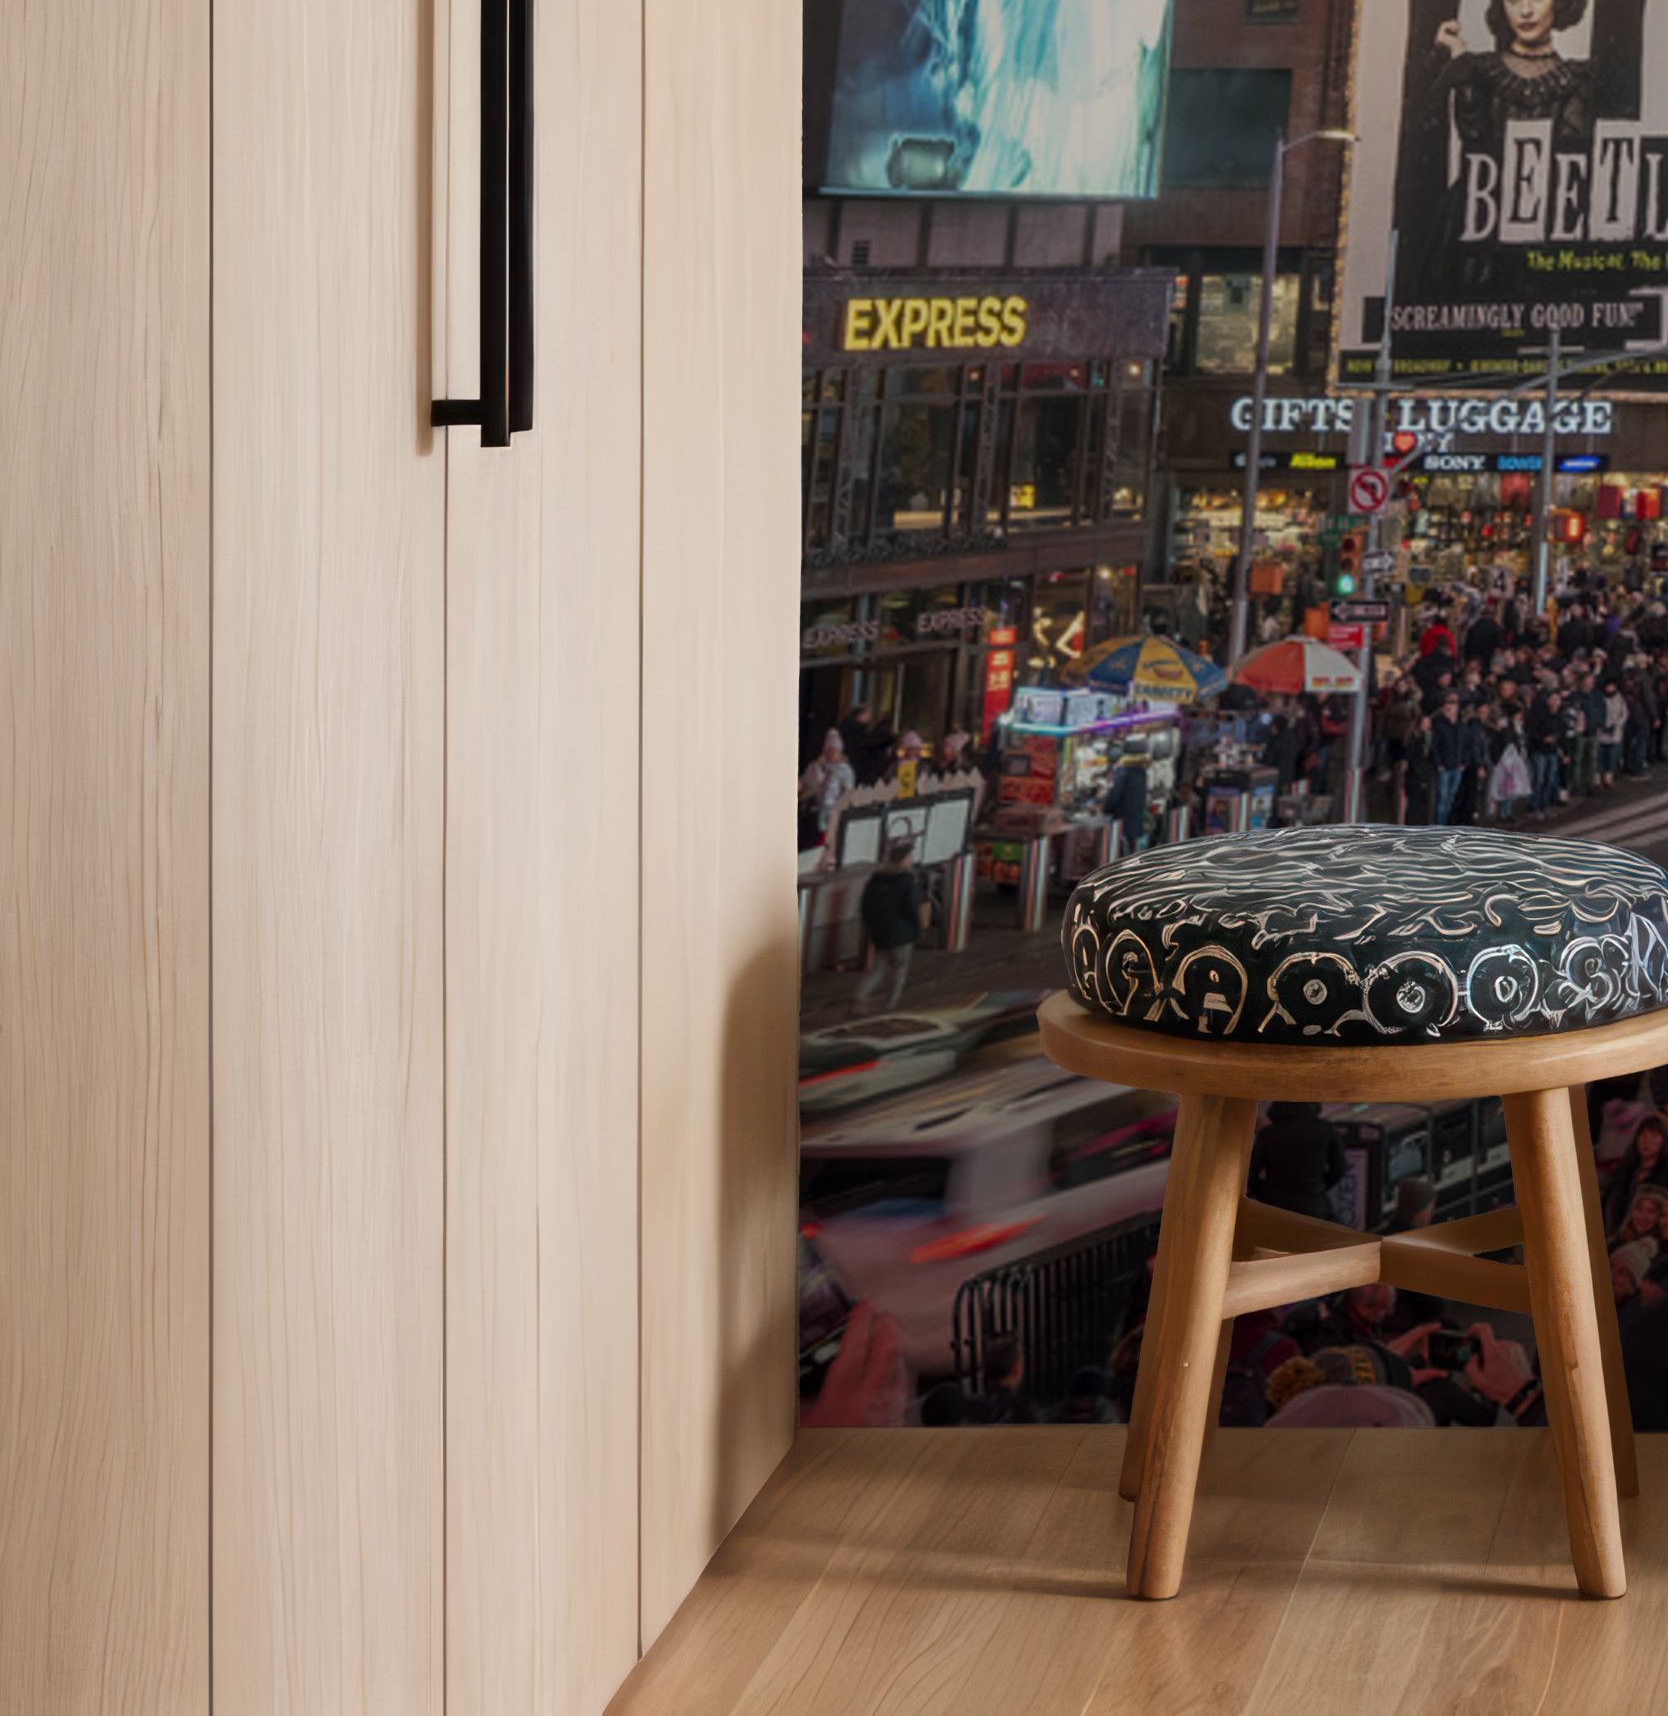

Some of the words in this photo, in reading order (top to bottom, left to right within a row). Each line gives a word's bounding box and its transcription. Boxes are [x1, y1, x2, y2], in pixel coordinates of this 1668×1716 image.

[1527, 250, 1555, 271] The
[1629, 250, 1658, 272] The
[844, 297, 1028, 351] EXPRESS
[1532, 302, 1585, 331] GOOD
[1231, 397, 1353, 433] GIFTS
[1396, 397, 1613, 435] LUGGAGE
[1423, 455, 1485, 471] SONY
